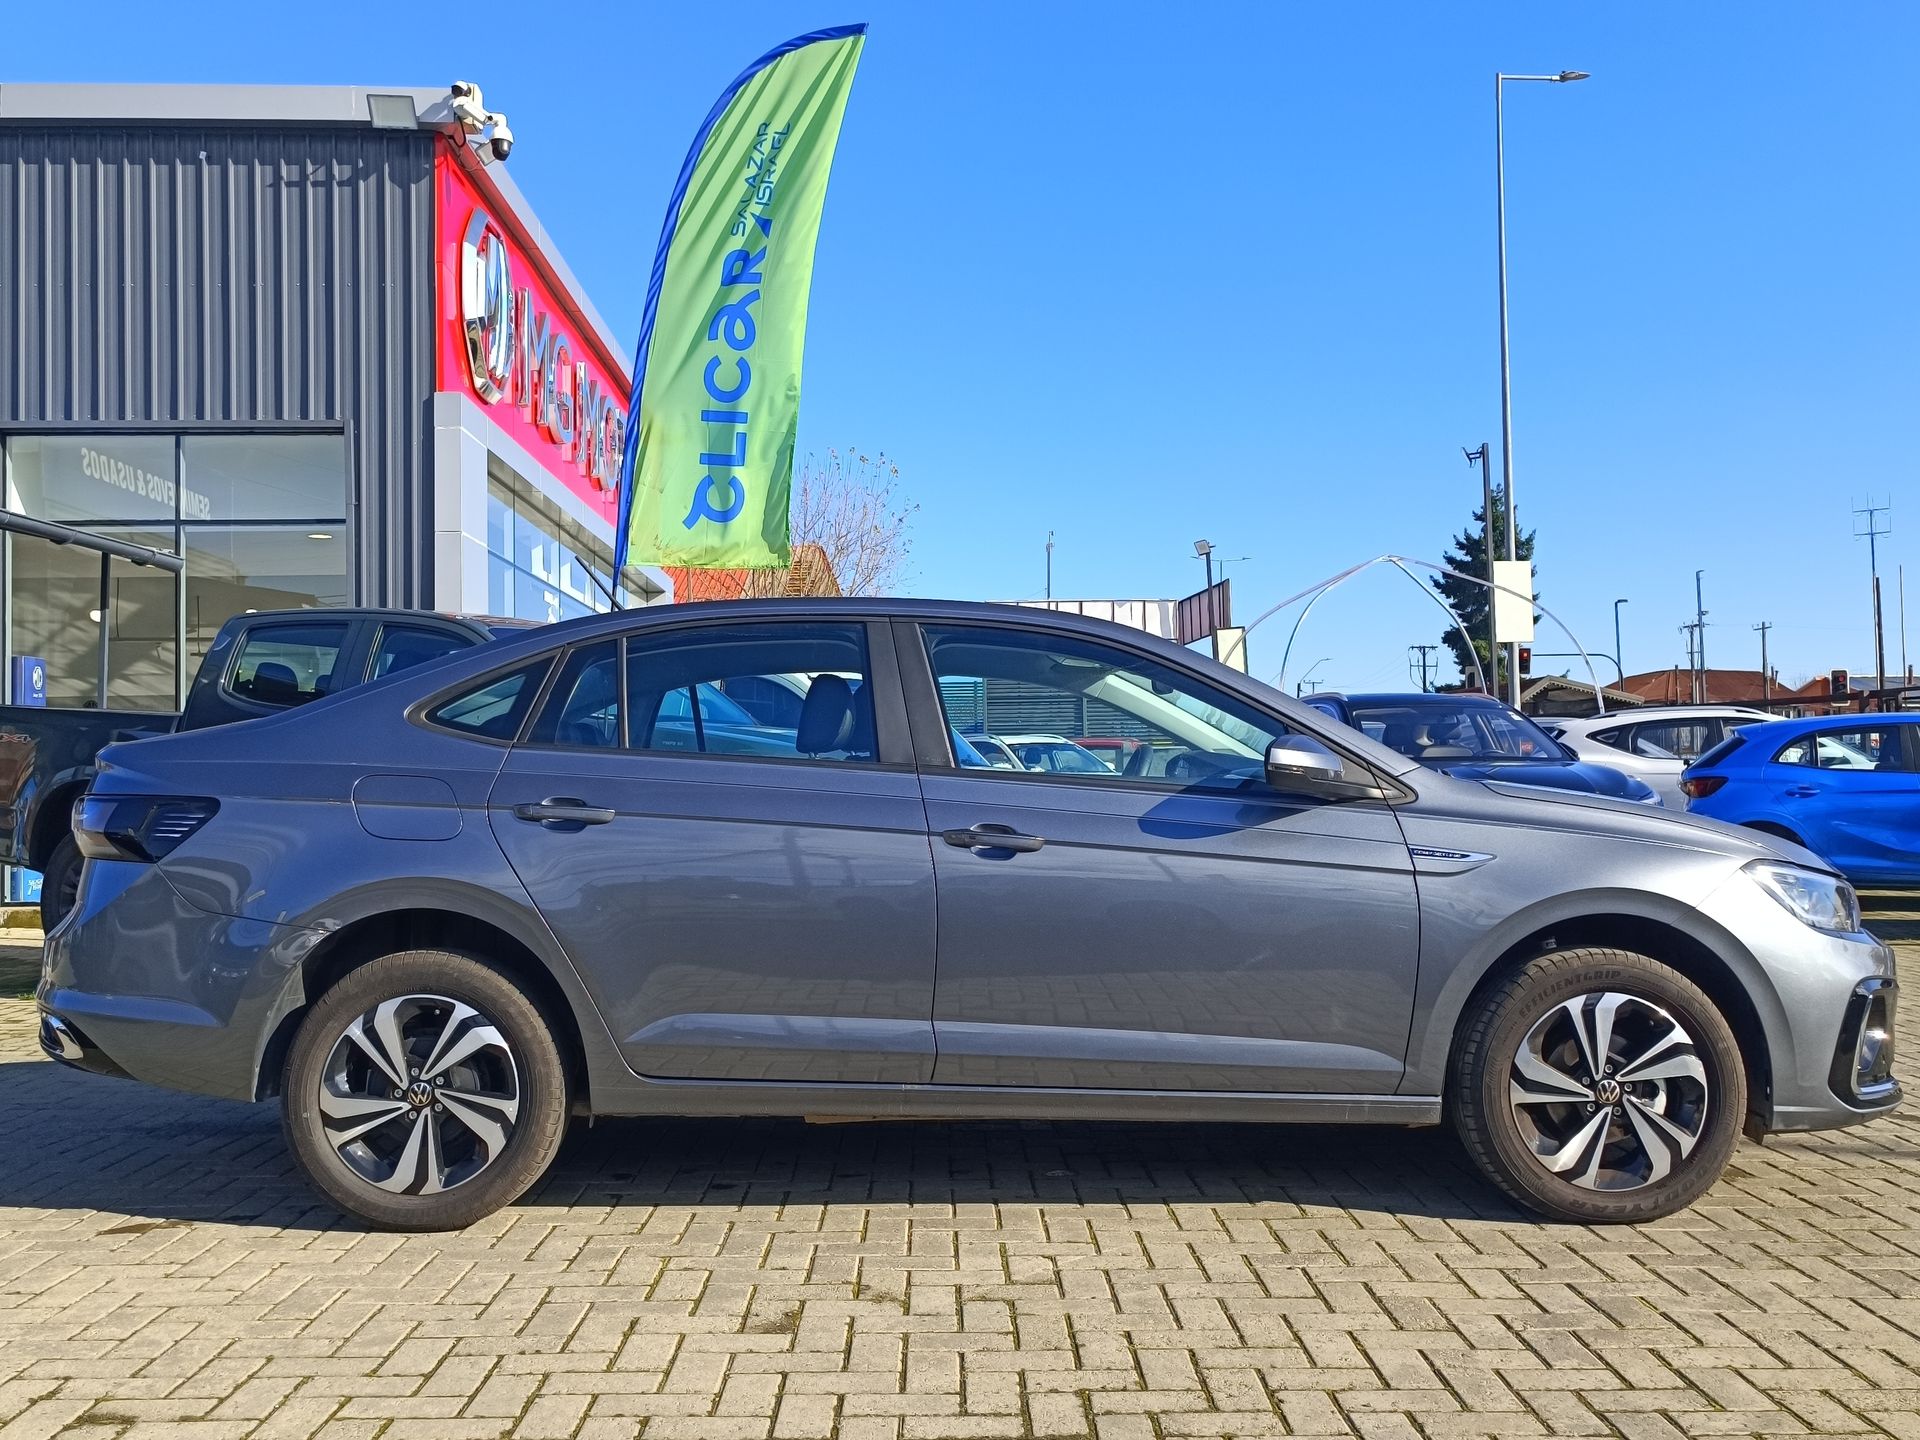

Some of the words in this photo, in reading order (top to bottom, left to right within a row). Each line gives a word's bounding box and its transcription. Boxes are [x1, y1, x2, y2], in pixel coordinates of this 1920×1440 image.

[731, 122, 771, 237] SALAZAR
[755, 122, 791, 206] ISRAEL
[1519, 970, 1622, 1019] EFFICIENTGRIP
